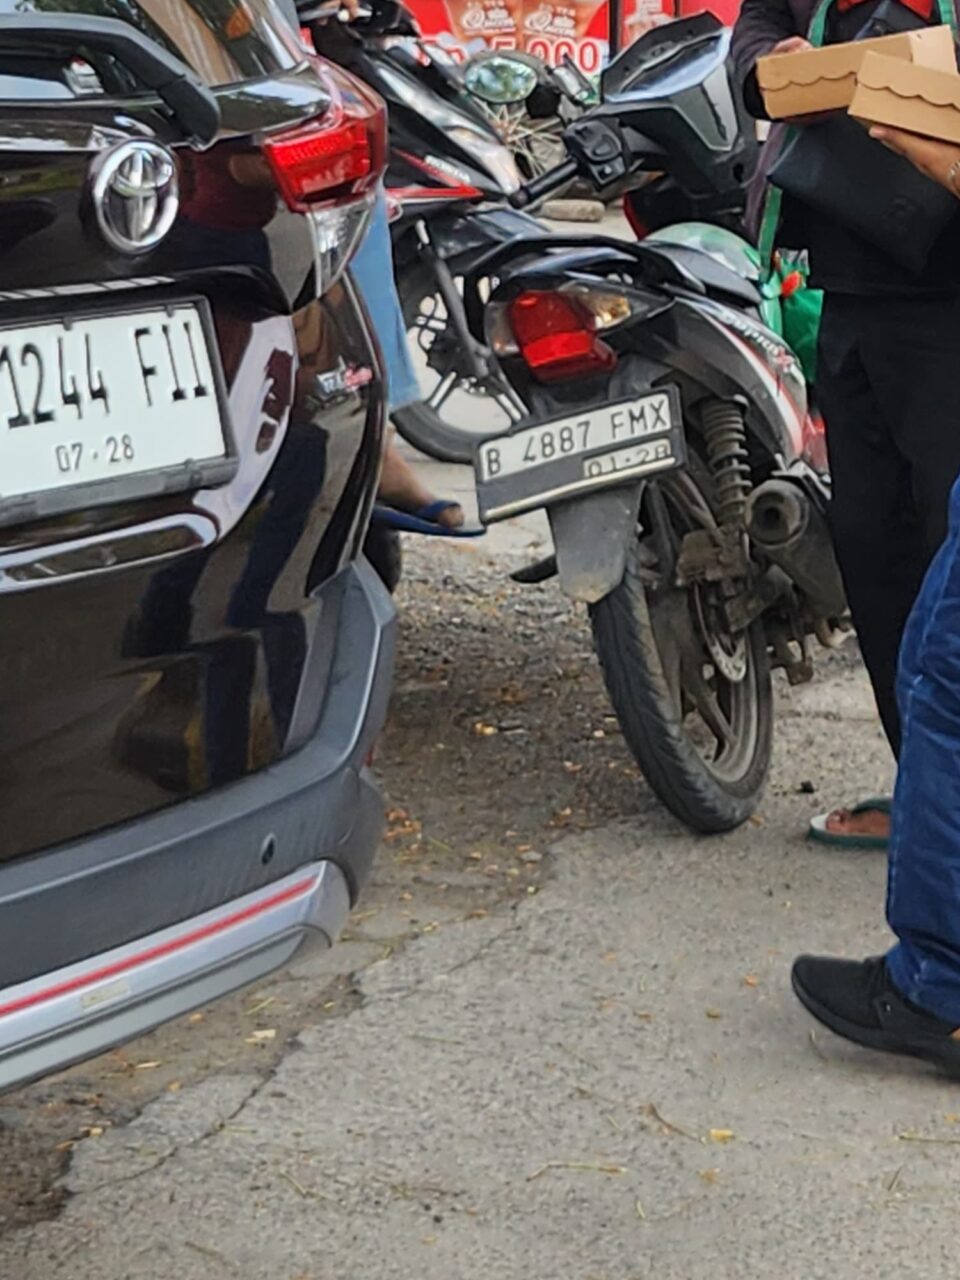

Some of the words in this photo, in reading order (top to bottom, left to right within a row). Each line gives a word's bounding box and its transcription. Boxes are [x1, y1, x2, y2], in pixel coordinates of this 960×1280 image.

[0, 333, 111, 429] 1244
[487, 448, 500, 476] B
[522, 421, 591, 462] 4887
[611, 400, 668, 439] FMX
